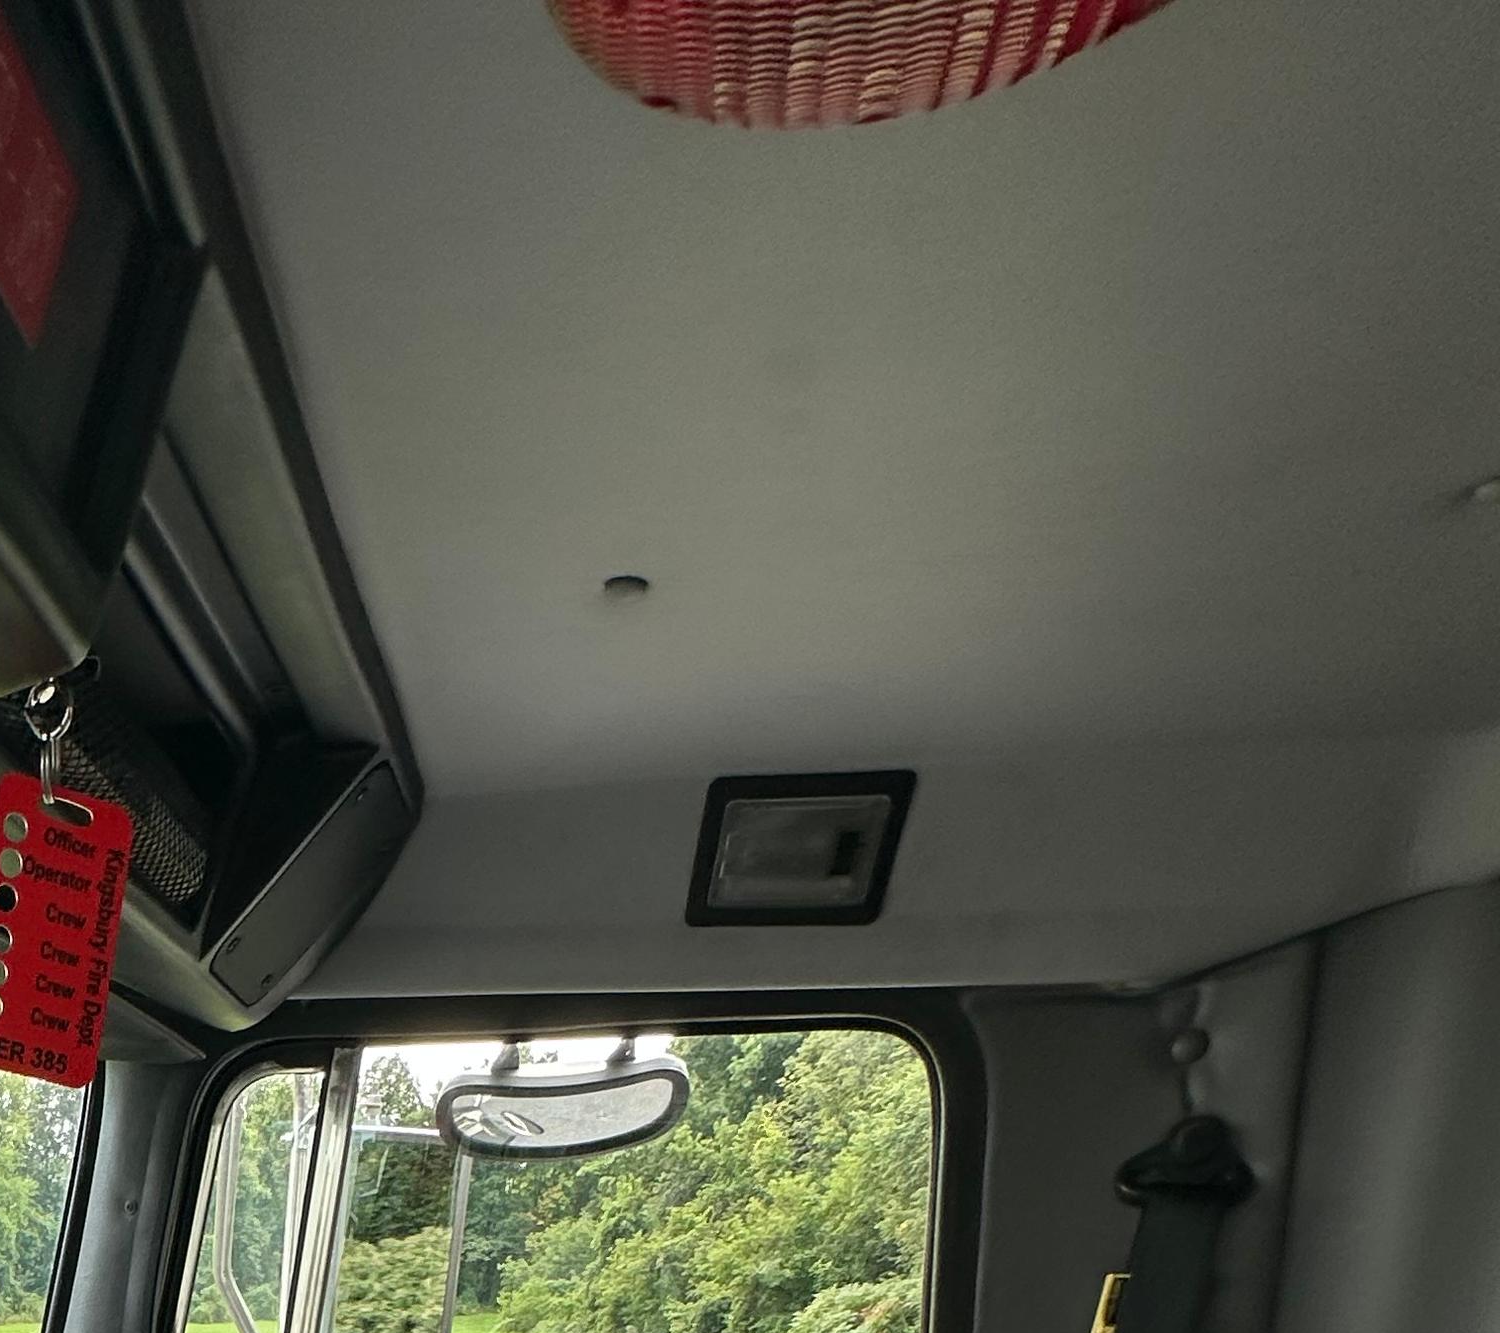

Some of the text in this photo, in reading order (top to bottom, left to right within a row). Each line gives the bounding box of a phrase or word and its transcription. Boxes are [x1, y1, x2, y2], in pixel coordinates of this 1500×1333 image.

[44, 828, 98, 859] Officer
[22, 856, 93, 893] Operator
[46, 903, 87, 930] Crew
[40, 941, 80, 968] Crew
[77, 849, 125, 1047] Kingsbury Fire Dept
[35, 974, 75, 1000] Crew
[30, 1008, 70, 1034] Crew
[30, 1047, 69, 1075] 385
